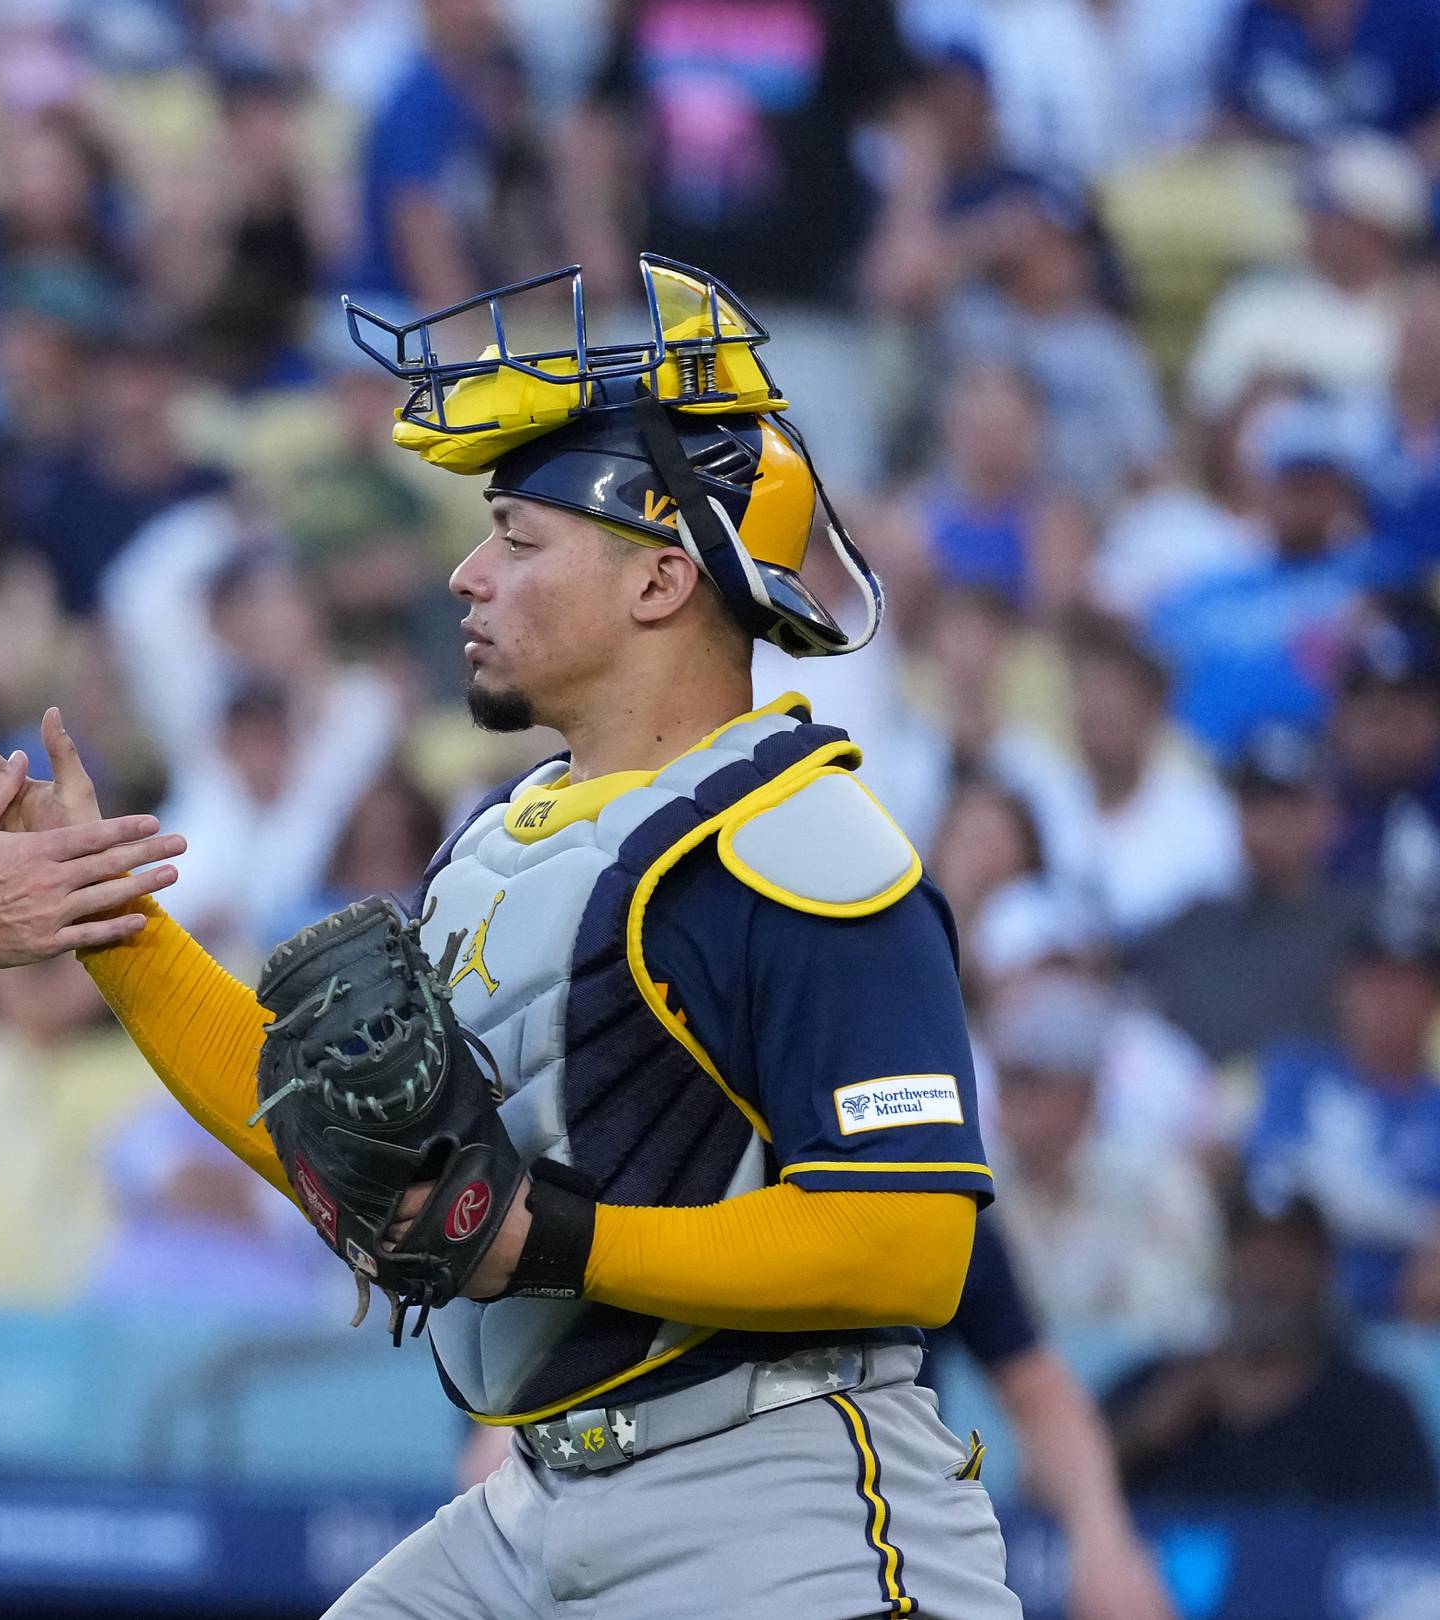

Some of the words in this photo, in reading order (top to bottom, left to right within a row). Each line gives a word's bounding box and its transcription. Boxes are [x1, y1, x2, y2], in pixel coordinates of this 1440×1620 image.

[872, 1088, 955, 1104] Northwestern
[875, 1099, 923, 1116] Mutual
[580, 1426, 606, 1453] X3
